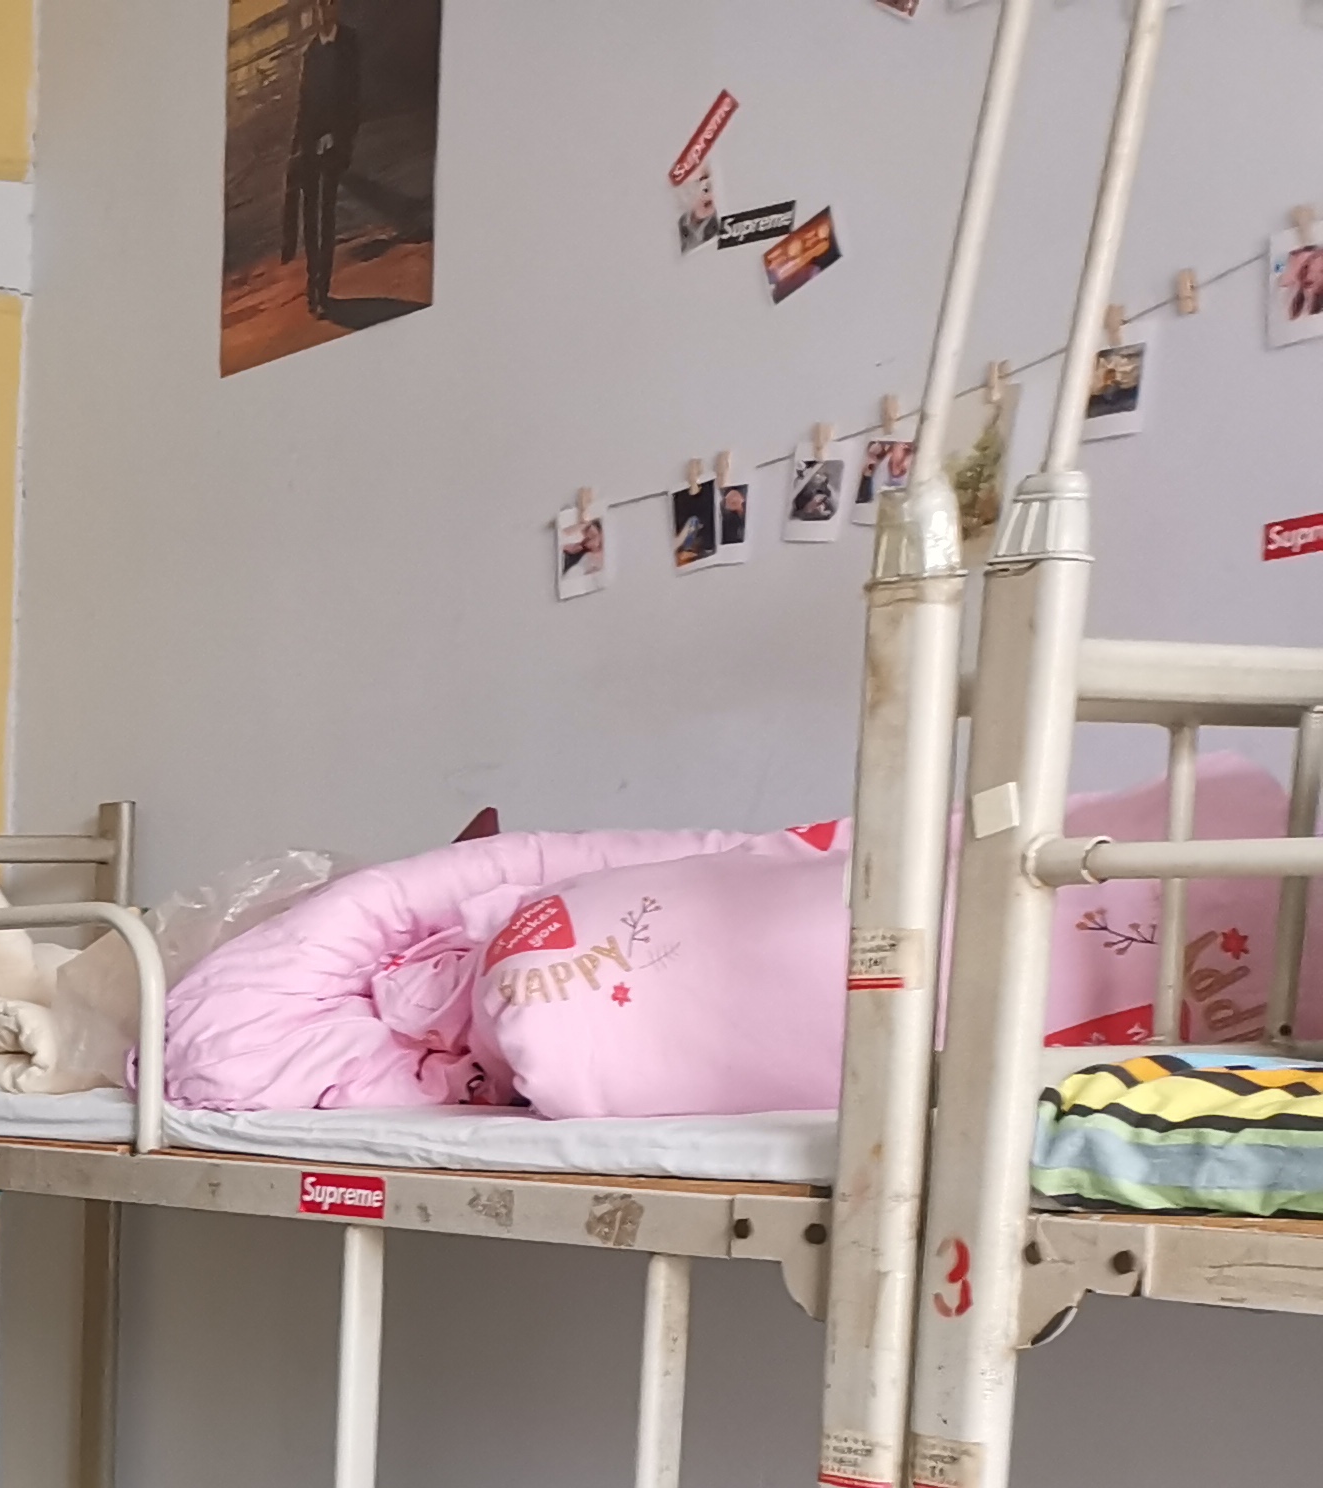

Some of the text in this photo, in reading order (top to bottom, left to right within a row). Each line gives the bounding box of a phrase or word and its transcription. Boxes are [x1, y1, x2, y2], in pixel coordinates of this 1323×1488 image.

[719, 210, 795, 242] Supreme
[497, 934, 633, 1006] HAPPY
[301, 1176, 385, 1211] Supreme
